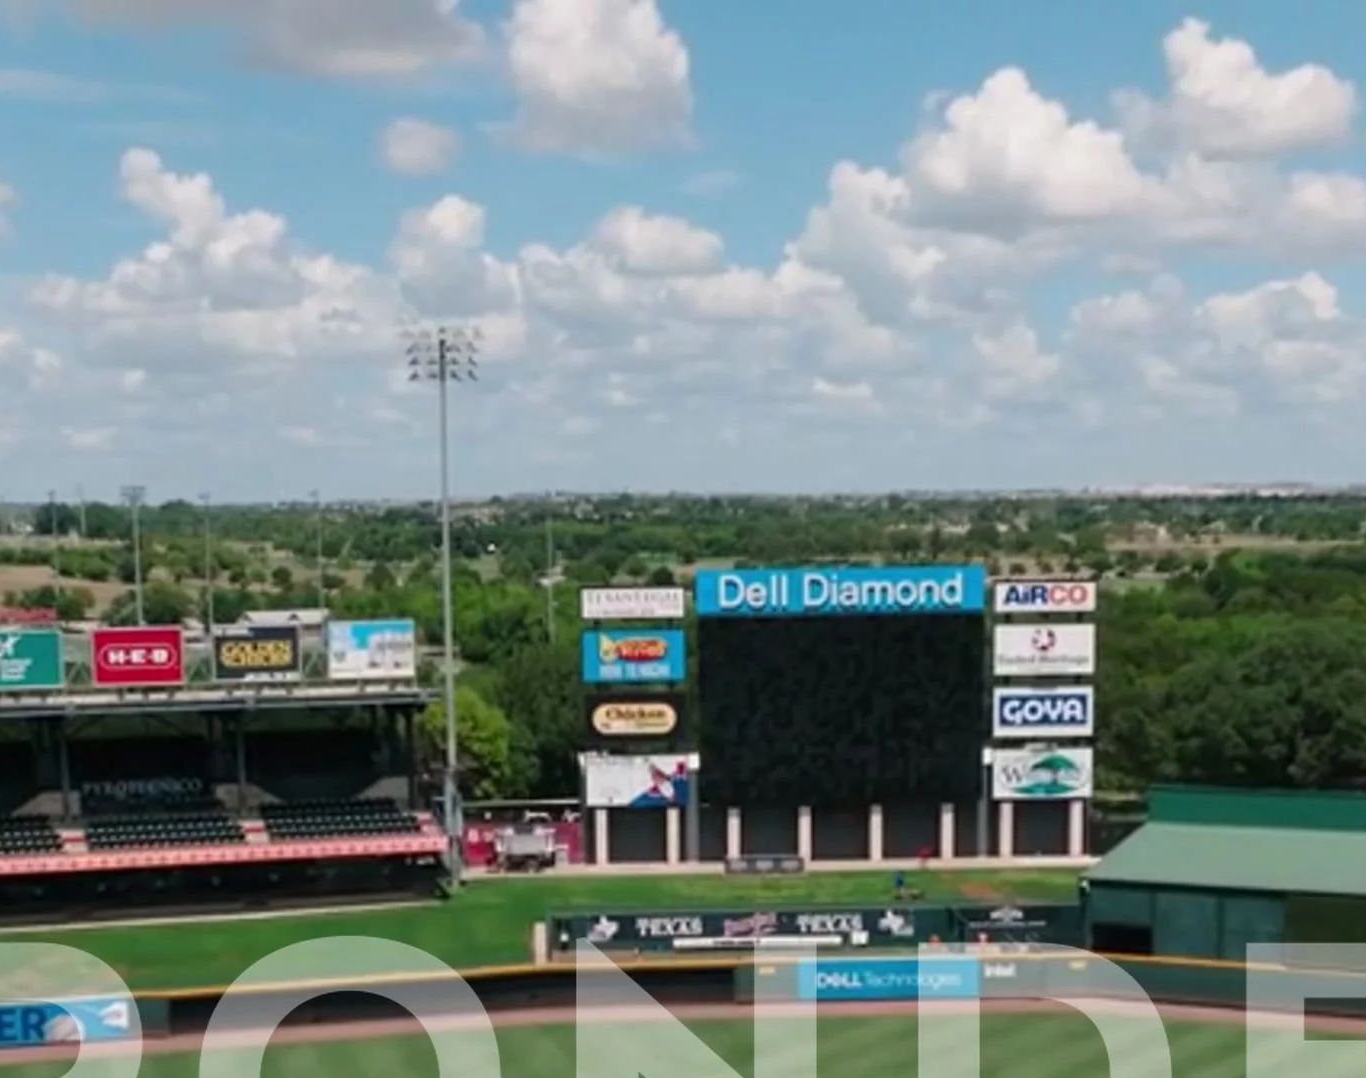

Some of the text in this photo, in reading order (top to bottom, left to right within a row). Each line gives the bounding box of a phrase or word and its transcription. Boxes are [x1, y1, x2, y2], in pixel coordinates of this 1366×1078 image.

[718, 571, 964, 607] Dell Diamond
[106, 648, 170, 665] H-E-B
[1002, 700, 1083, 723] GOYA
[636, 917, 702, 936] TEXAS
[796, 914, 863, 932] TEXAS
[817, 971, 862, 988] DELL
